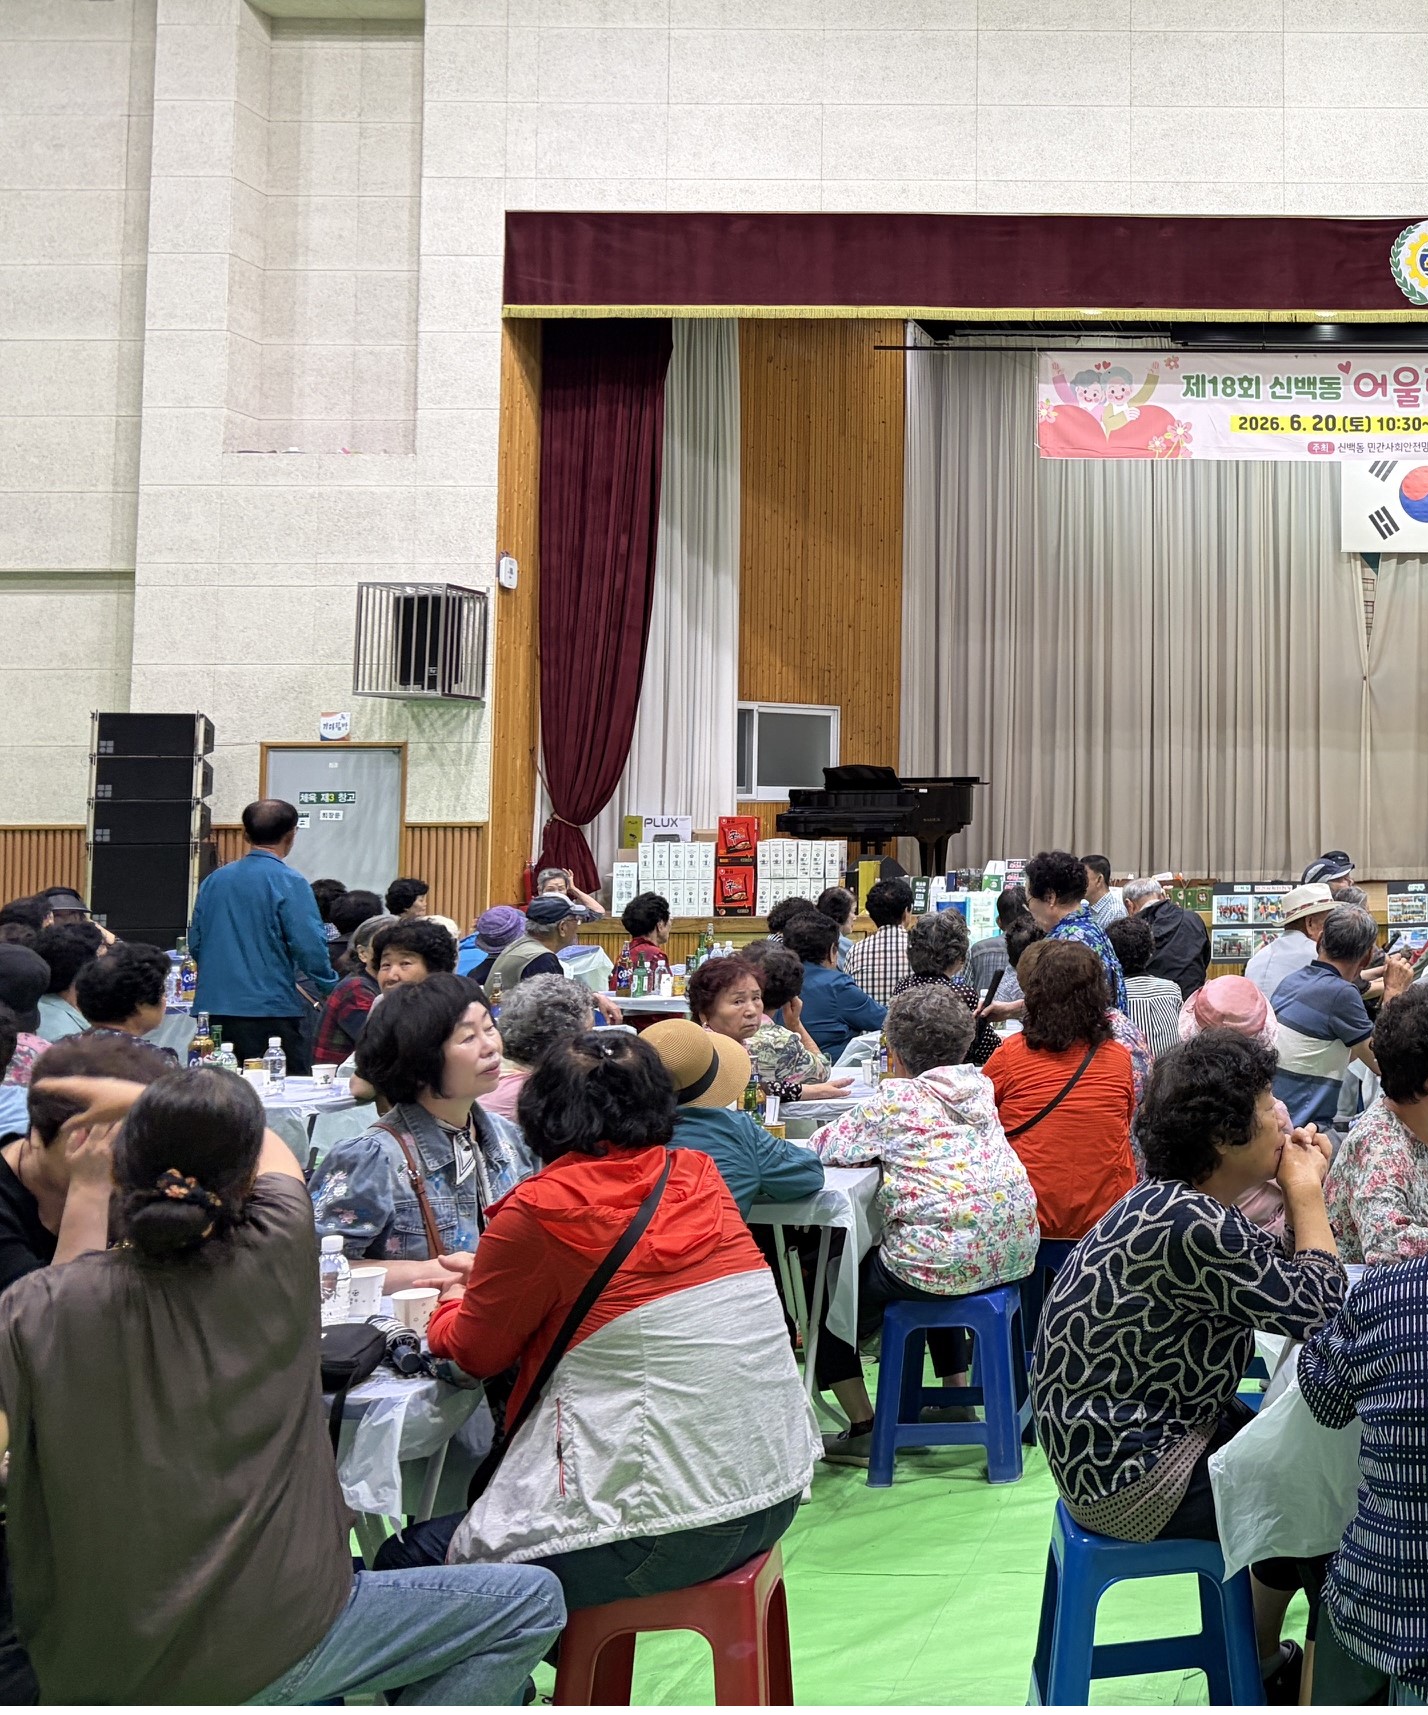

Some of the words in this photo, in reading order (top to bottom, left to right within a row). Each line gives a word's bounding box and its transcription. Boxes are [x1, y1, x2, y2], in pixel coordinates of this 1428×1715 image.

[1181, 374, 1261, 400] 제18회
[1269, 375, 1342, 400] 신백동
[1238, 416, 1285, 431] 2026.
[1289, 414, 1307, 431] 6.
[1312, 414, 1372, 433] 20.(토)
[1312, 443, 1330, 453] 주최
[1337, 442, 1364, 454] 신백동
[300, 793, 317, 803] 체육
[337, 792, 355, 803] 창고
[644, 817, 679, 828] PLUX
[183, 972, 197, 983] Cas
